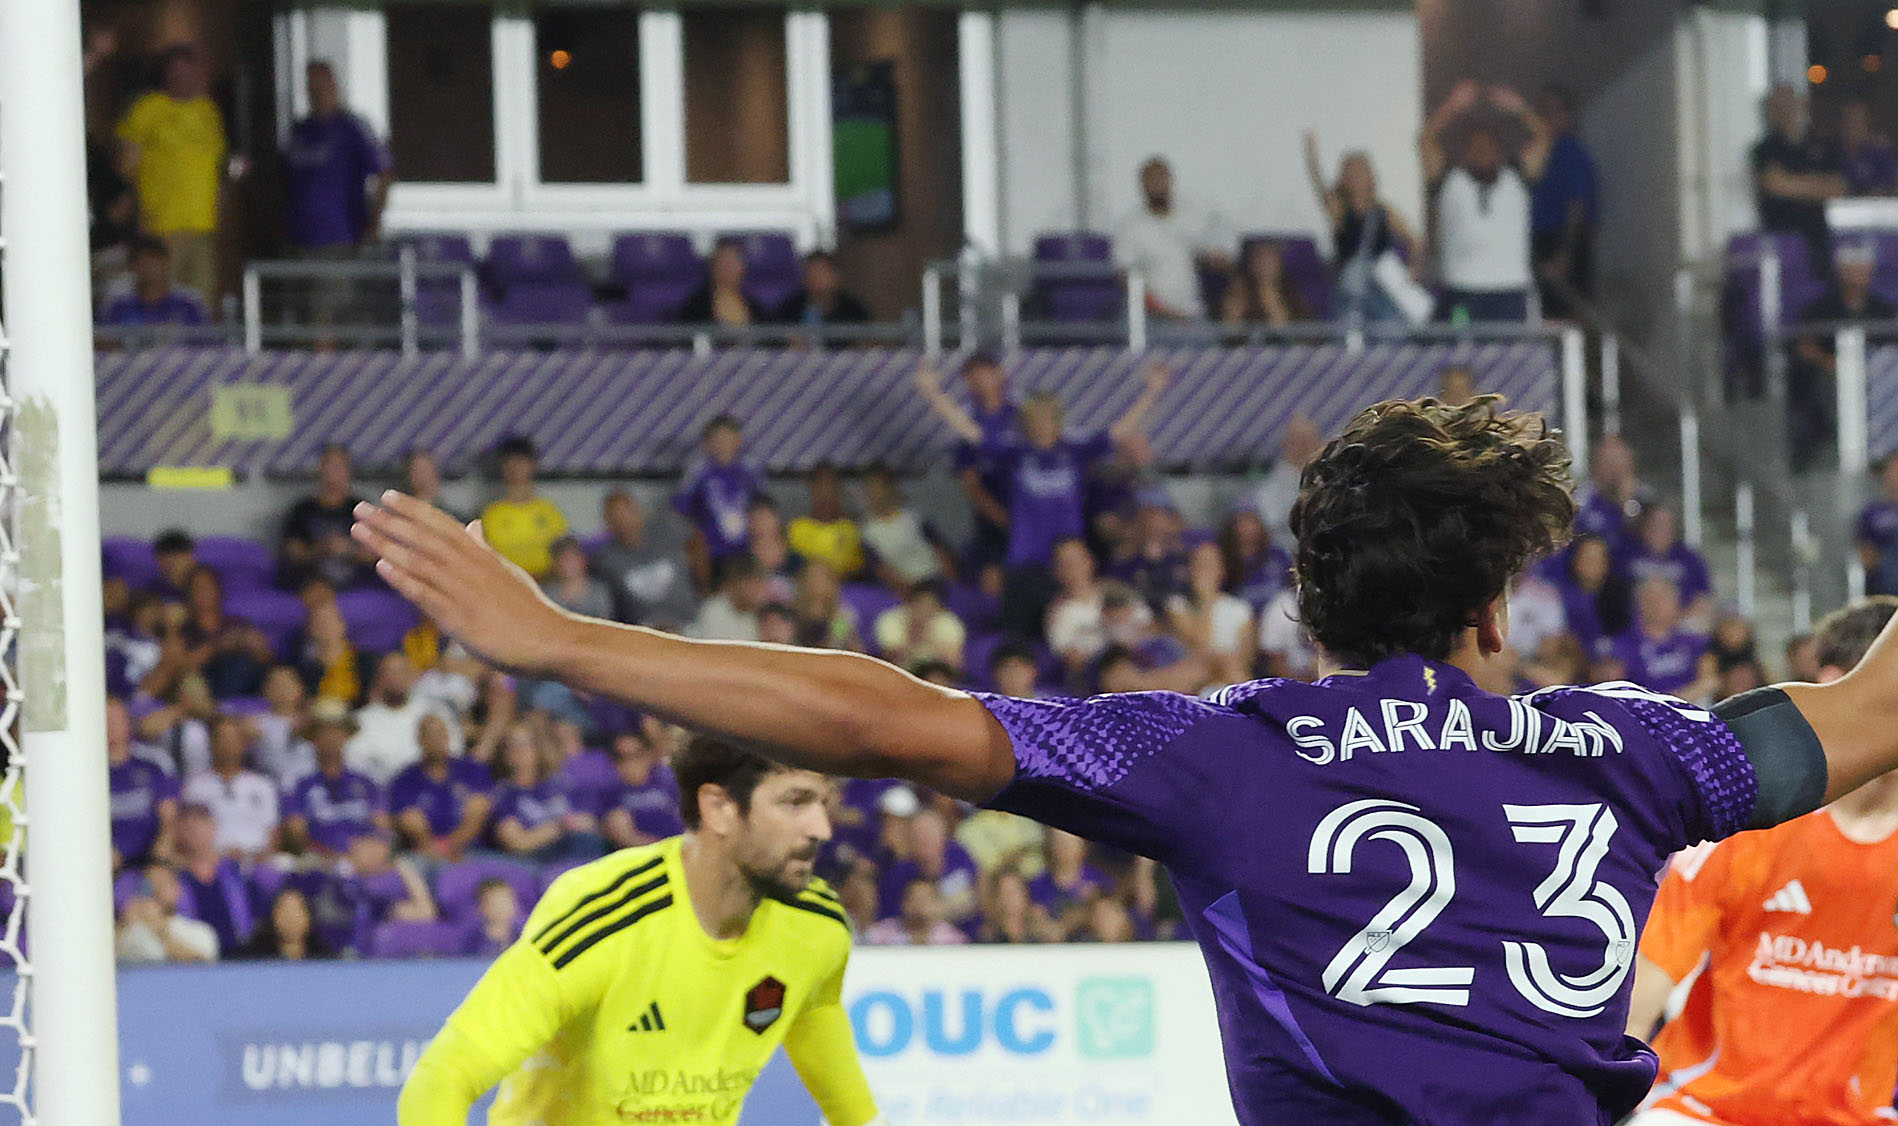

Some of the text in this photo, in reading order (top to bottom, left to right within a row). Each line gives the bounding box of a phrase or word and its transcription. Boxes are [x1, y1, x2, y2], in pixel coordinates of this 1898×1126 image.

[1285, 698, 1623, 765] SARAJIAN
[1307, 799, 1637, 1018] 23
[849, 988, 1055, 1057] OUC
[243, 1040, 430, 1090] UNBELI
